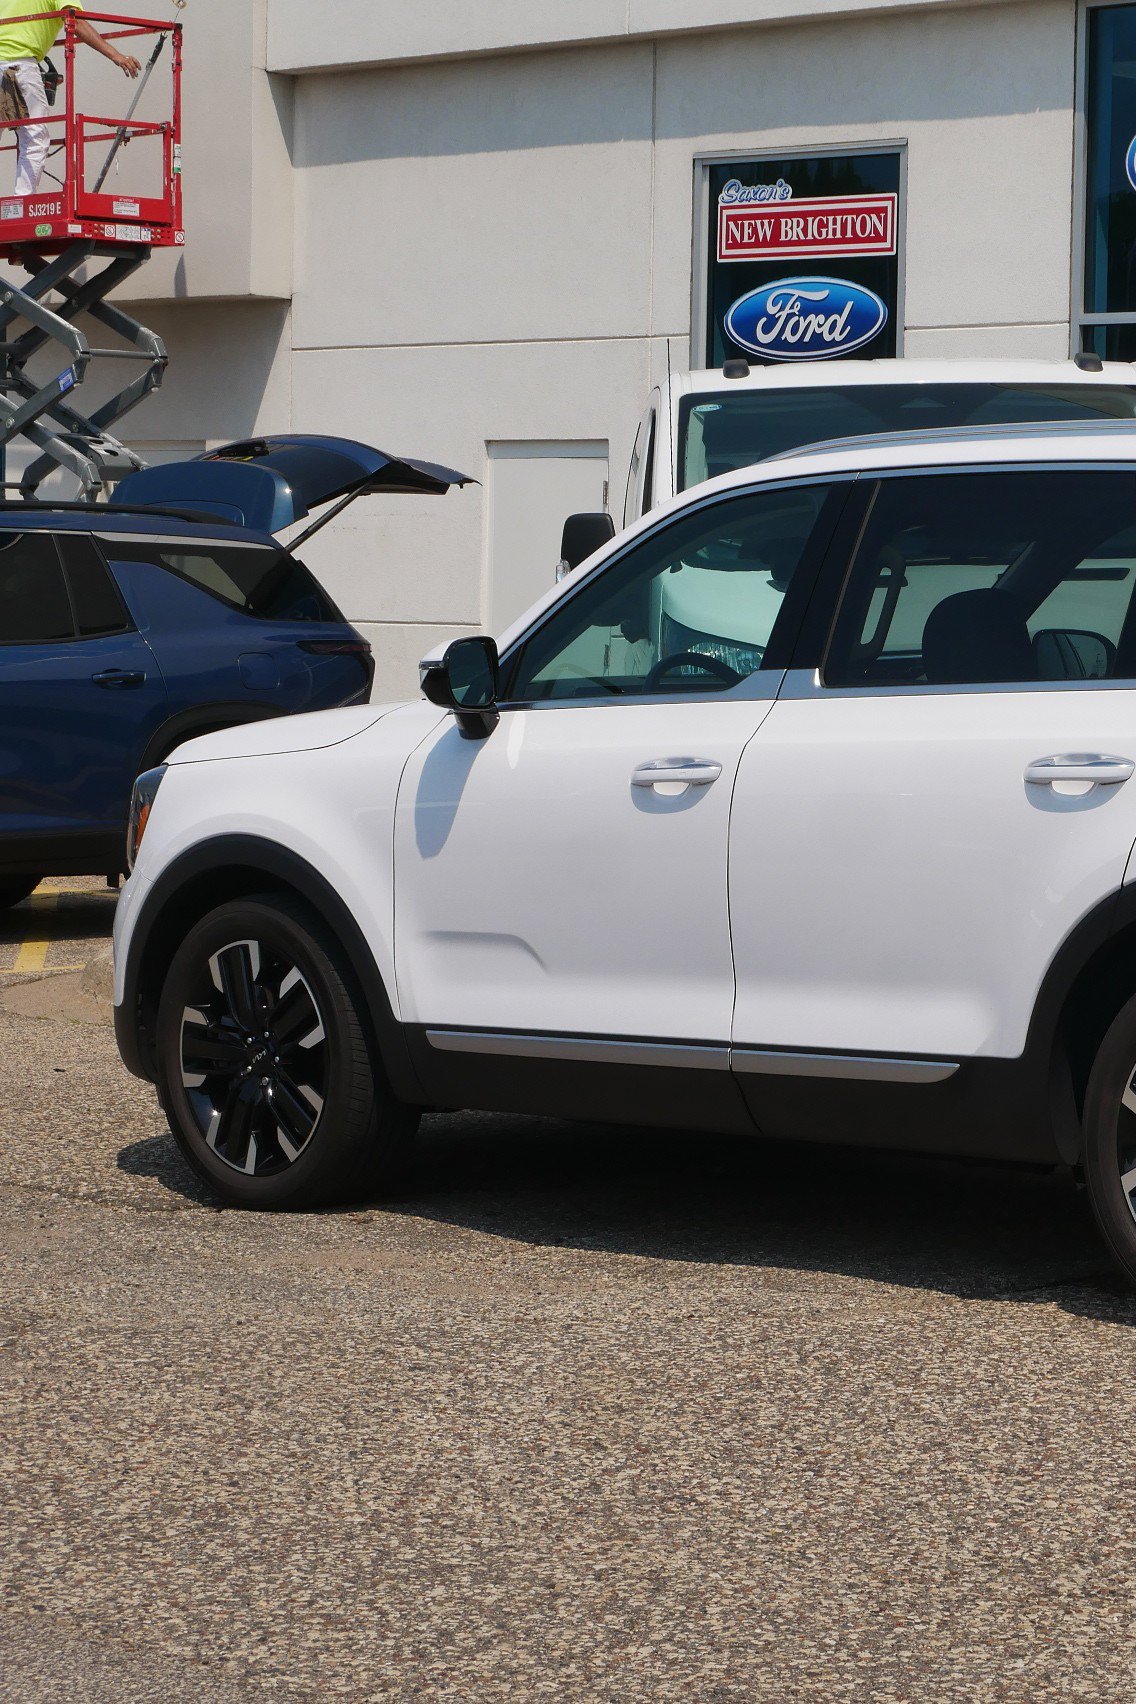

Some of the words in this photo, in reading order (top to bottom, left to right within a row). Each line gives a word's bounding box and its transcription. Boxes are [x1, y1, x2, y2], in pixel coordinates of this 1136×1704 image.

[719, 179, 791, 204] Saxon's
[28, 203, 55, 217] SJ3219
[727, 218, 775, 244] NEW
[779, 213, 886, 242] BRIGHTON
[756, 287, 855, 345] Ford
